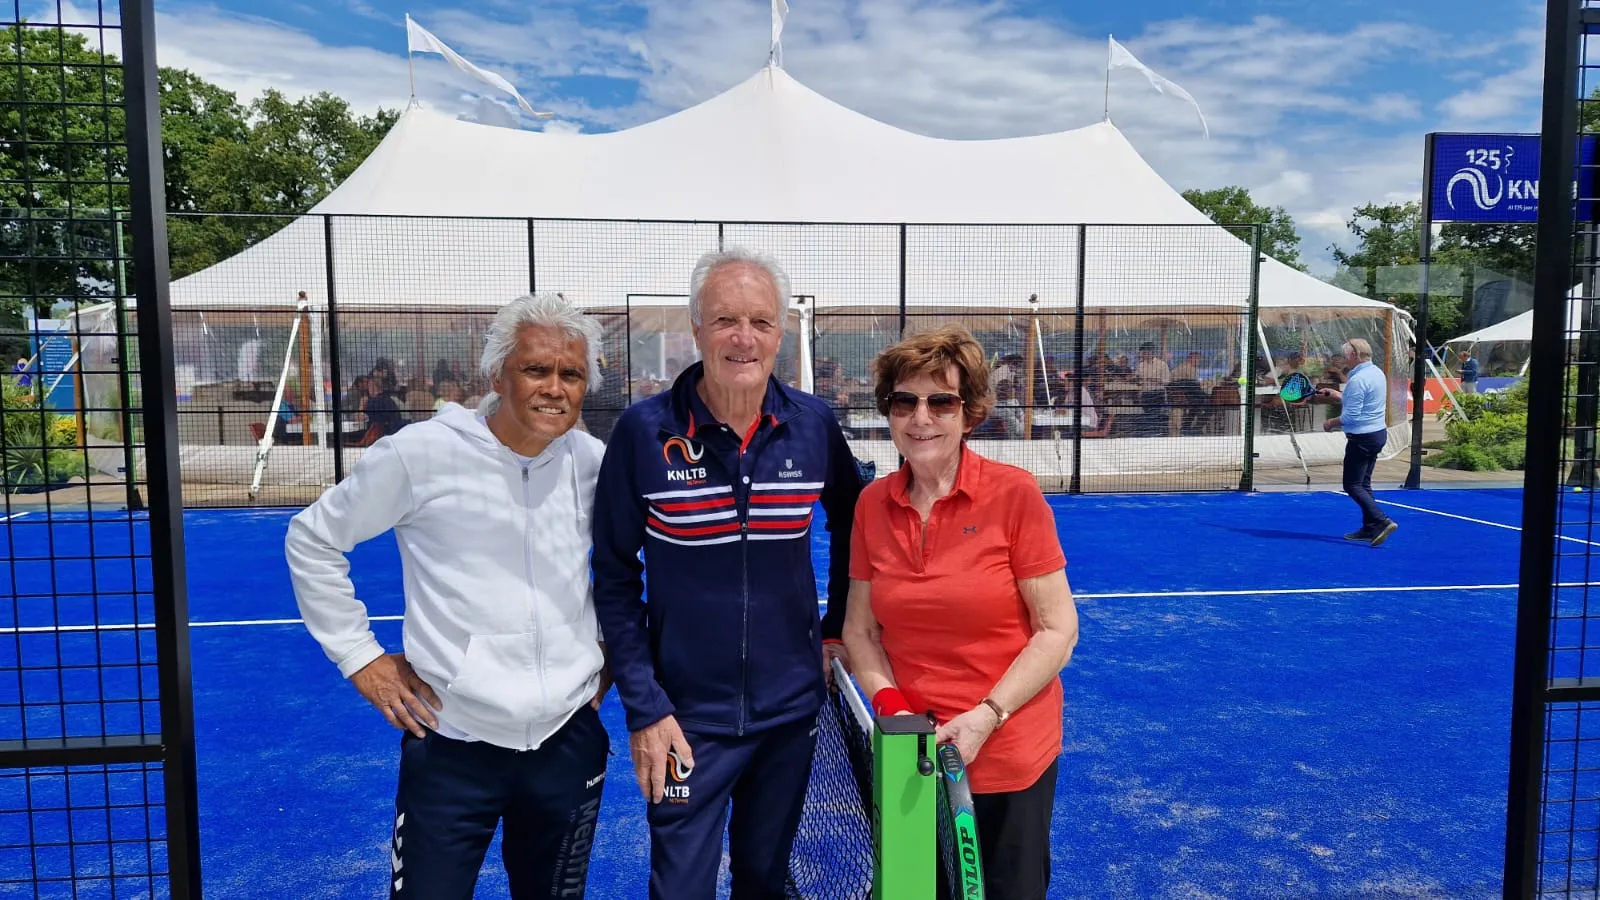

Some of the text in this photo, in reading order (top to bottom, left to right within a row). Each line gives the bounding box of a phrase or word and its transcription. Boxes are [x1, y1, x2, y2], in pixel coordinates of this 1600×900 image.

[1466, 148, 1501, 170] 125
[667, 467, 707, 481] KNLTB
[663, 786, 690, 798] NLTB
[960, 826, 979, 900] NLOP
